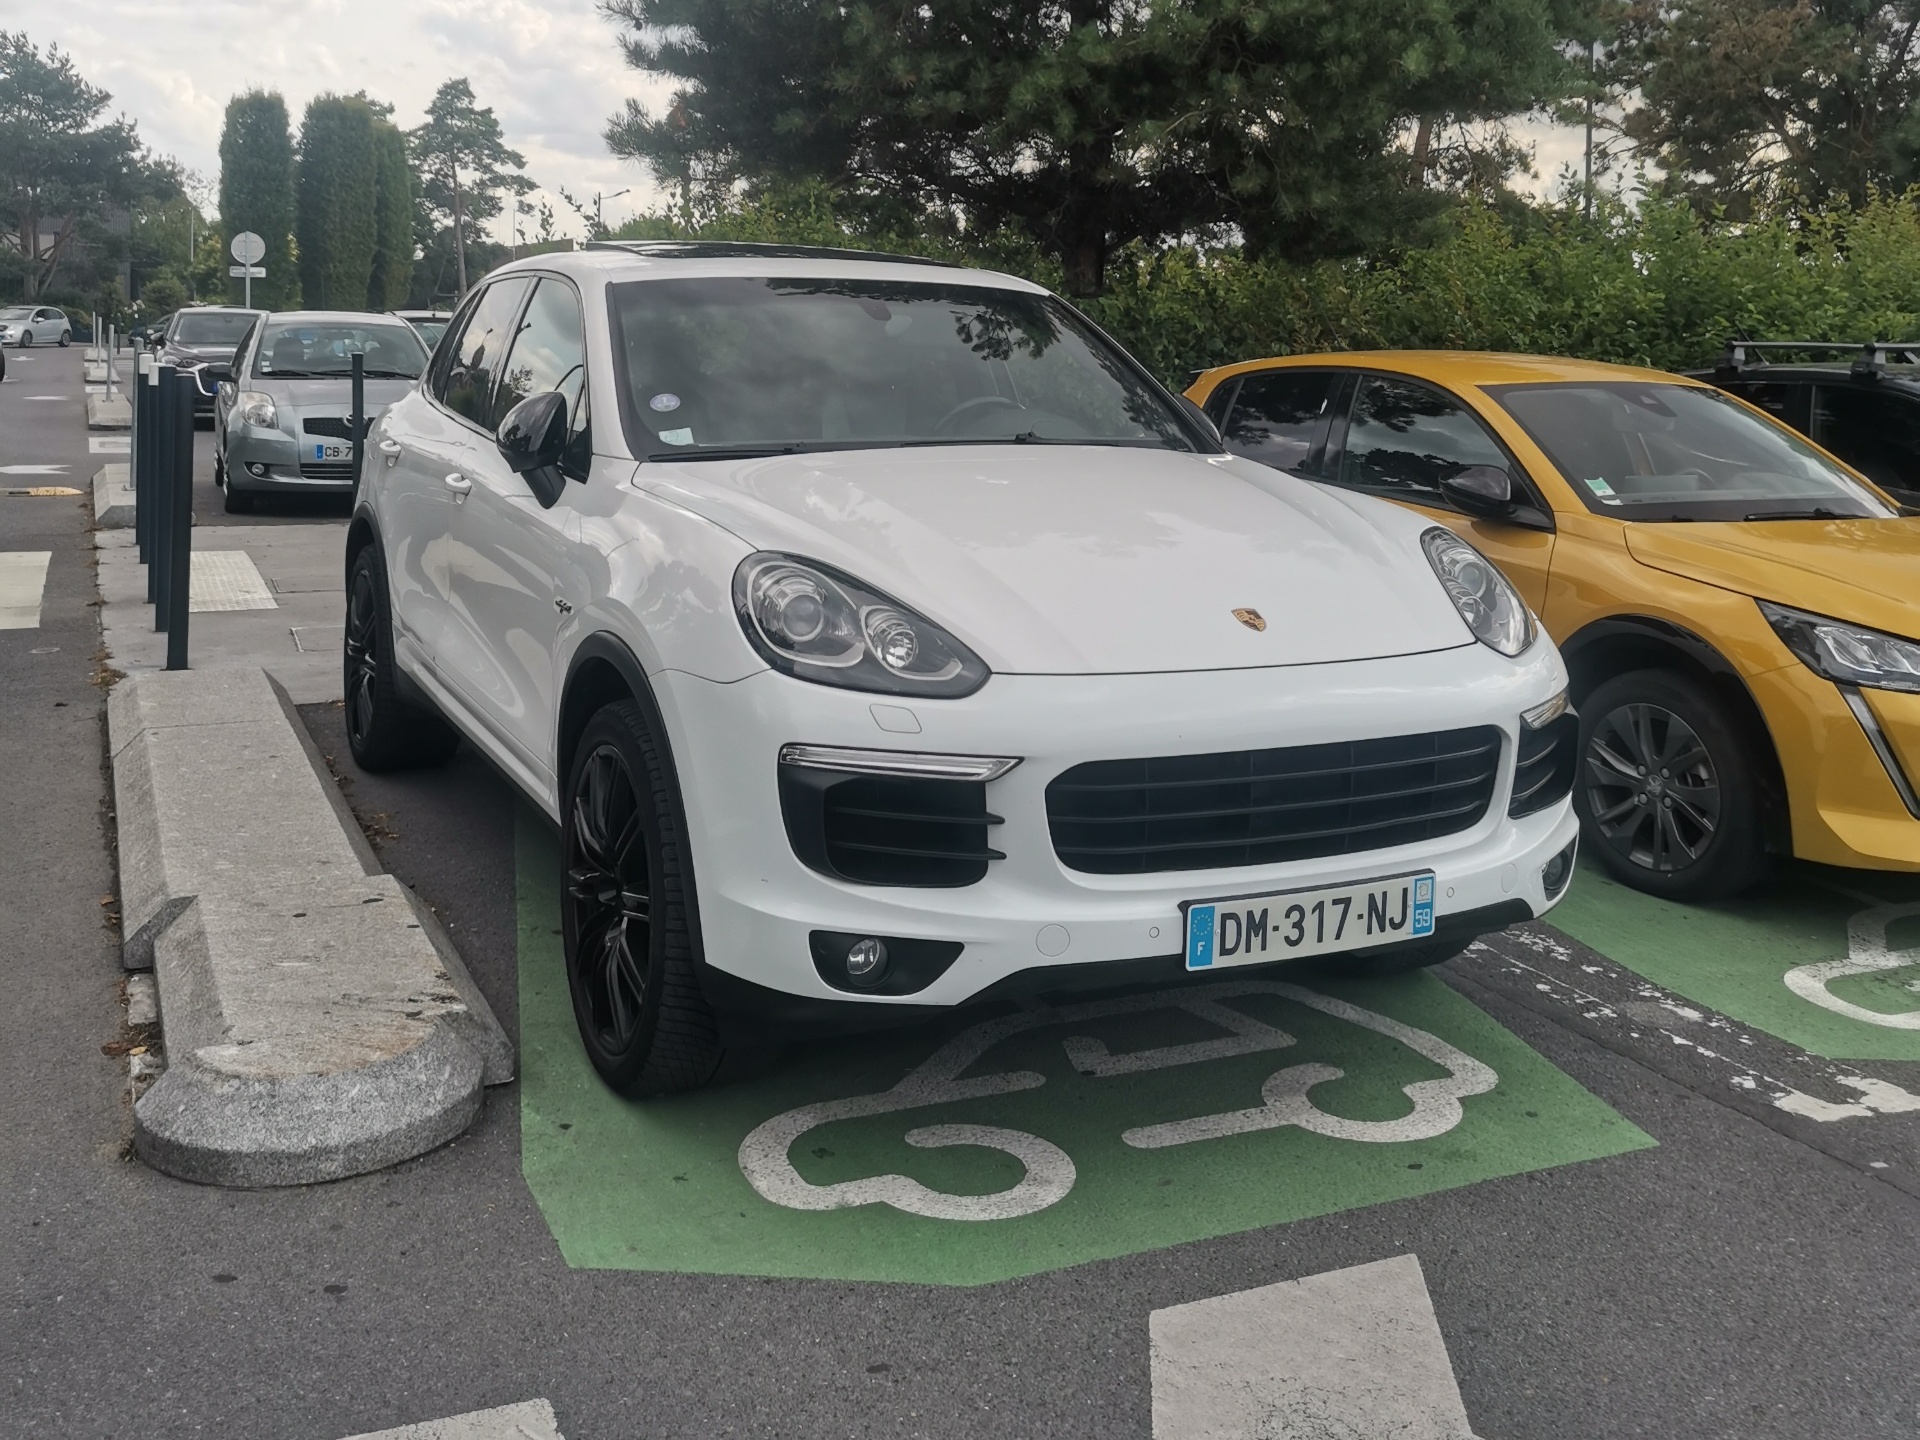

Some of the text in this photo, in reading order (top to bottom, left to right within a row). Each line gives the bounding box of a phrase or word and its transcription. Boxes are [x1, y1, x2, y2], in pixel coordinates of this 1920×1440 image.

[1197, 887, 1431, 957] F DM-317-NJ 59
